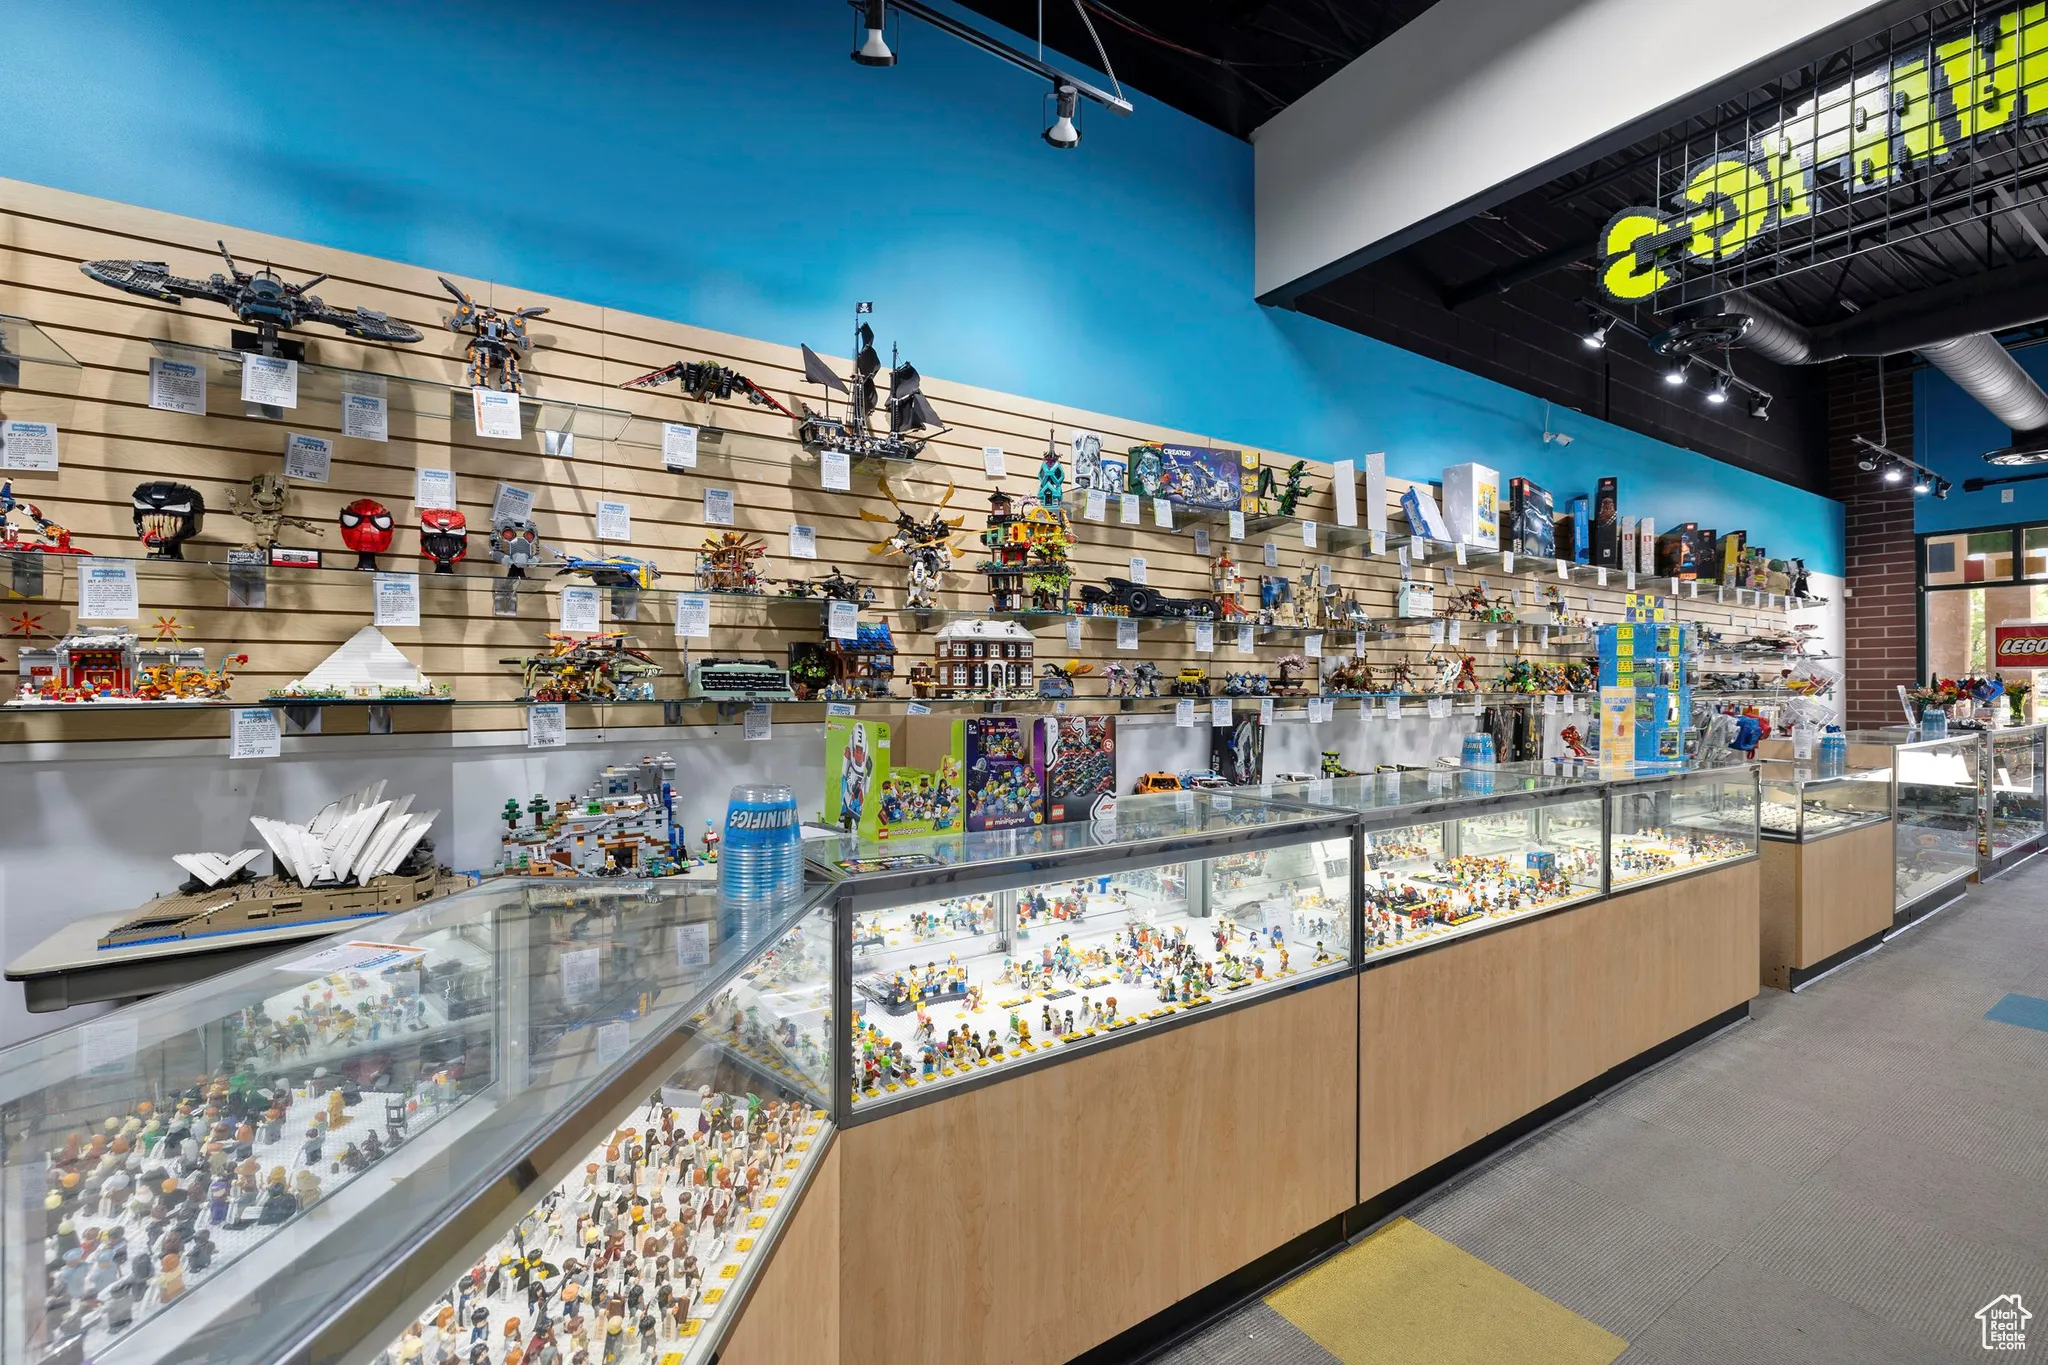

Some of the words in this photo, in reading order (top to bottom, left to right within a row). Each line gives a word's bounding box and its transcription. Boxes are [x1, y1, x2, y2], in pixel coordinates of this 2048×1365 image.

[2000, 638, 2048, 654] LEGO
[730, 809, 792, 829] MINIFIGS
[995, 817, 1025, 825] minifigures
[890, 827, 925, 837] minifigures
